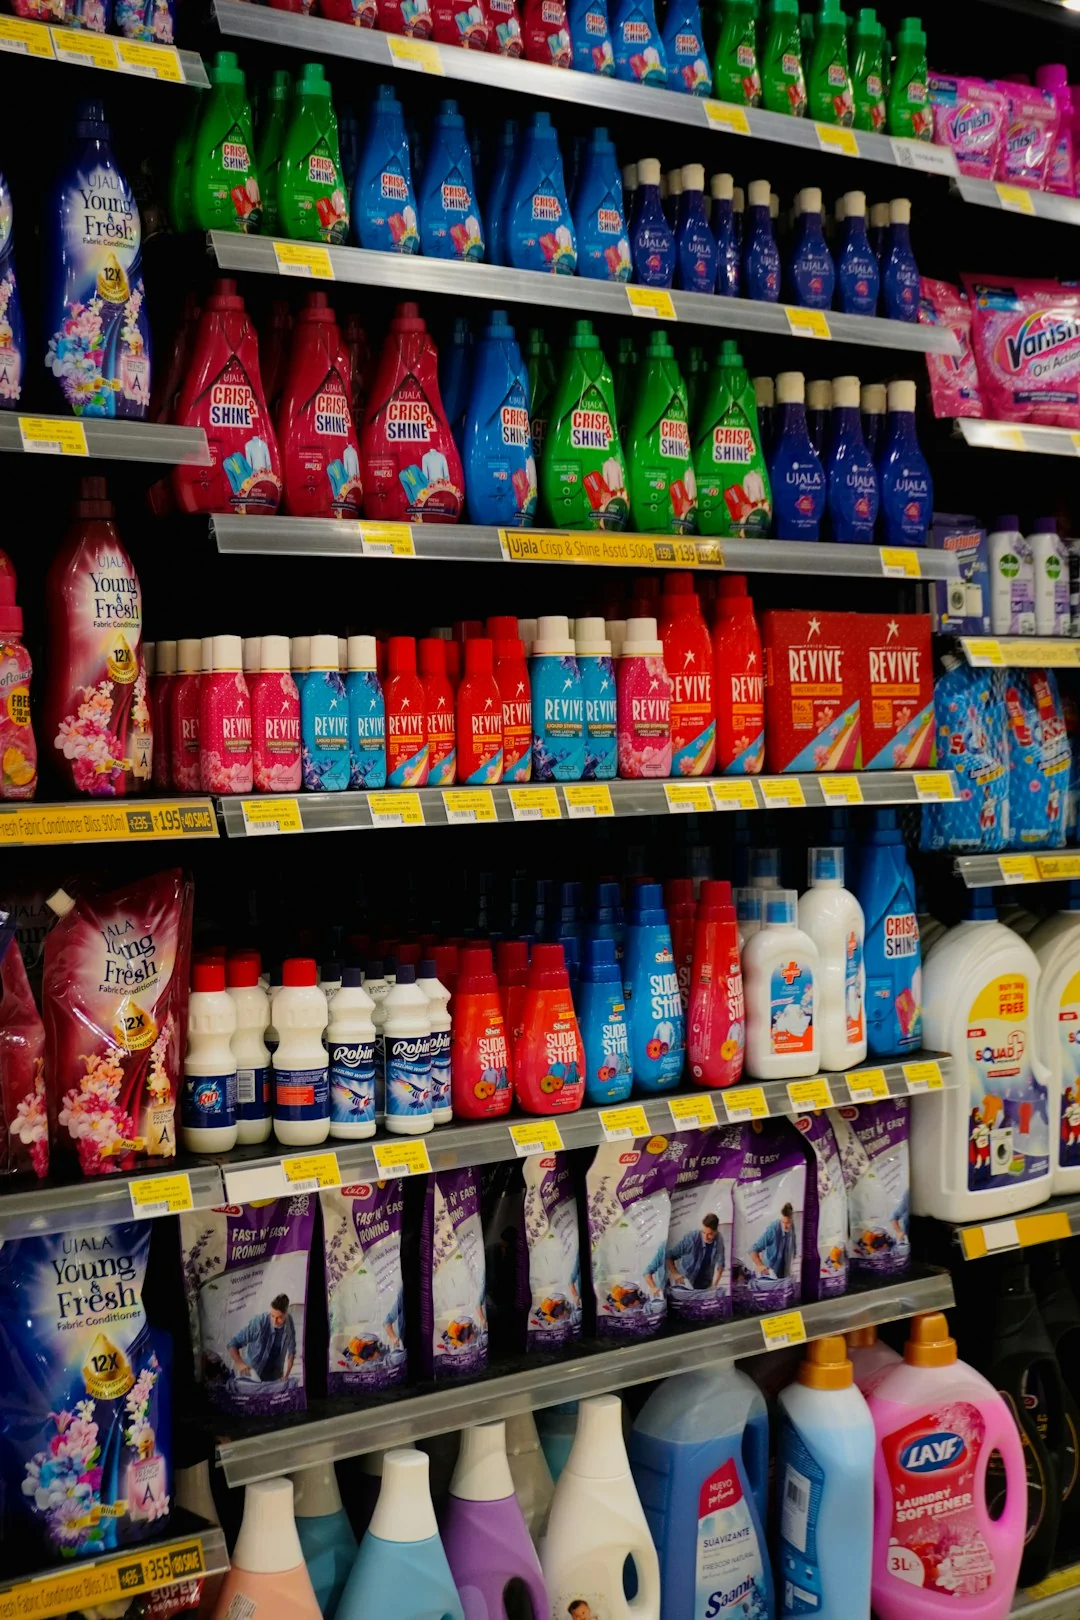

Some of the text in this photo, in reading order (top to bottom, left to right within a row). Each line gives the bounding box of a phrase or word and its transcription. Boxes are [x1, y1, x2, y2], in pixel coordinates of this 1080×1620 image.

[624, 22, 647, 33] CRISP
[950, 109, 991, 139] Vanish
[224, 144, 246, 157] CRISP
[310, 157, 331, 170] CRISP
[310, 169, 332, 182] SHINE
[382, 174, 404, 188] CRISP
[444, 185, 466, 198] CRISP
[80, 189, 133, 221] Young
[534, 196, 557, 208] CRISP
[84, 215, 134, 241] Fresh
[83, 237, 102, 245] Fabric
[639, 238, 667, 248] UJALA
[689, 243, 710, 253] UJALA
[104, 267, 121, 281] 12X
[802, 261, 829, 271] UJALA
[848, 263, 873, 274] UJALA
[1007, 320, 1080, 369] Vanish
[1033, 363, 1051, 377] Oxi
[213, 387, 250, 405] CRISP
[399, 391, 420, 399] UJALA
[317, 396, 345, 414] CRISP
[388, 404, 427, 421] CRISP
[212, 406, 251, 425] SHINE
[317, 414, 347, 433] SHINE
[503, 408, 527, 427] CRISP
[573, 412, 607, 430] CRISP
[388, 422, 428, 439] SHINE
[503, 427, 529, 445] SHINE
[573, 430, 607, 447] SHINE
[661, 422, 686, 438] CRISP
[715, 428, 748, 445] CRISP
[661, 439, 688, 457] SHINE
[715, 445, 749, 461] SHINE
[786, 472, 821, 485] UJALA
[847, 475, 875, 488] UJALA
[896, 479, 927, 492] UJALA
[511, 539, 654, 562] Ujala Crisp & Shine Asstd 500g
[98, 556, 126, 568] UJALA
[89, 572, 138, 599] Young
[96, 598, 139, 620] Fresh
[93, 620, 112, 628] Fabric
[114, 649, 130, 663] 12X
[788, 650, 843, 683] REVIVE
[869, 651, 920, 683] REVIVE
[669, 675, 711, 702] REVIVE
[12, 695, 30, 708] FREE
[545, 699, 583, 721] REVIVE
[586, 700, 617, 721] REVIVE
[632, 699, 670, 721] REVIVE
[12, 708, 24, 716] 210
[265, 719, 300, 739] REVIVE
[315, 716, 348, 736] REVIVE
[389, 716, 423, 735] REVIVE
[472, 715, 502, 734] REVIVE
[19, 817, 40, 836] Fabric
[42, 815, 83, 835] Conditioner
[84, 815, 100, 832] Bliss
[101, 814, 125, 831] 900ml
[194, 811, 211, 827] SAVE
[886, 916, 914, 936] CRISP
[886, 936, 915, 956] SHINE
[104, 959, 158, 986] Fresh
[99, 984, 120, 995] Fabric
[999, 1002, 1024, 1015] FREE
[333, 1045, 374, 1064] Robin
[392, 1039, 430, 1059] Robin
[975, 1047, 1014, 1063] SQUAD
[121, 1140, 137, 1150] Aura
[701, 1156, 721, 1167] EASY
[760, 1153, 779, 1164] EASY
[344, 1185, 366, 1195] LuLu
[460, 1185, 478, 1199] EASY
[387, 1201, 403, 1216] EAS
[232, 1226, 290, 1242] FAST EASY
[360, 1220, 390, 1244] IRONING
[232, 1243, 266, 1261] IRONING
[51, 1256, 136, 1285] Young
[90, 1280, 101, 1295] &
[57, 1281, 139, 1318] Fresh
[57, 1310, 141, 1331] Fabric Conditioner
[91, 1352, 120, 1373] 12X
[906, 1437, 959, 1468] LAYF
[710, 1479, 732, 1492] NUEVO
[896, 1488, 952, 1511] LAUNDRY
[896, 1493, 972, 1522] SOFTENER
[703, 1527, 750, 1548] SUAVIZANTE
[703, 1551, 754, 1571] FRESCOR NATURAL
[892, 1558, 909, 1571] 3L
[17, 1591, 39, 1614] Fabric
[41, 1579, 82, 1608] Conditioner
[83, 1575, 100, 1596] Bliss
[151, 1579, 197, 1604] SUPER
[705, 1574, 756, 1618] Saamix
